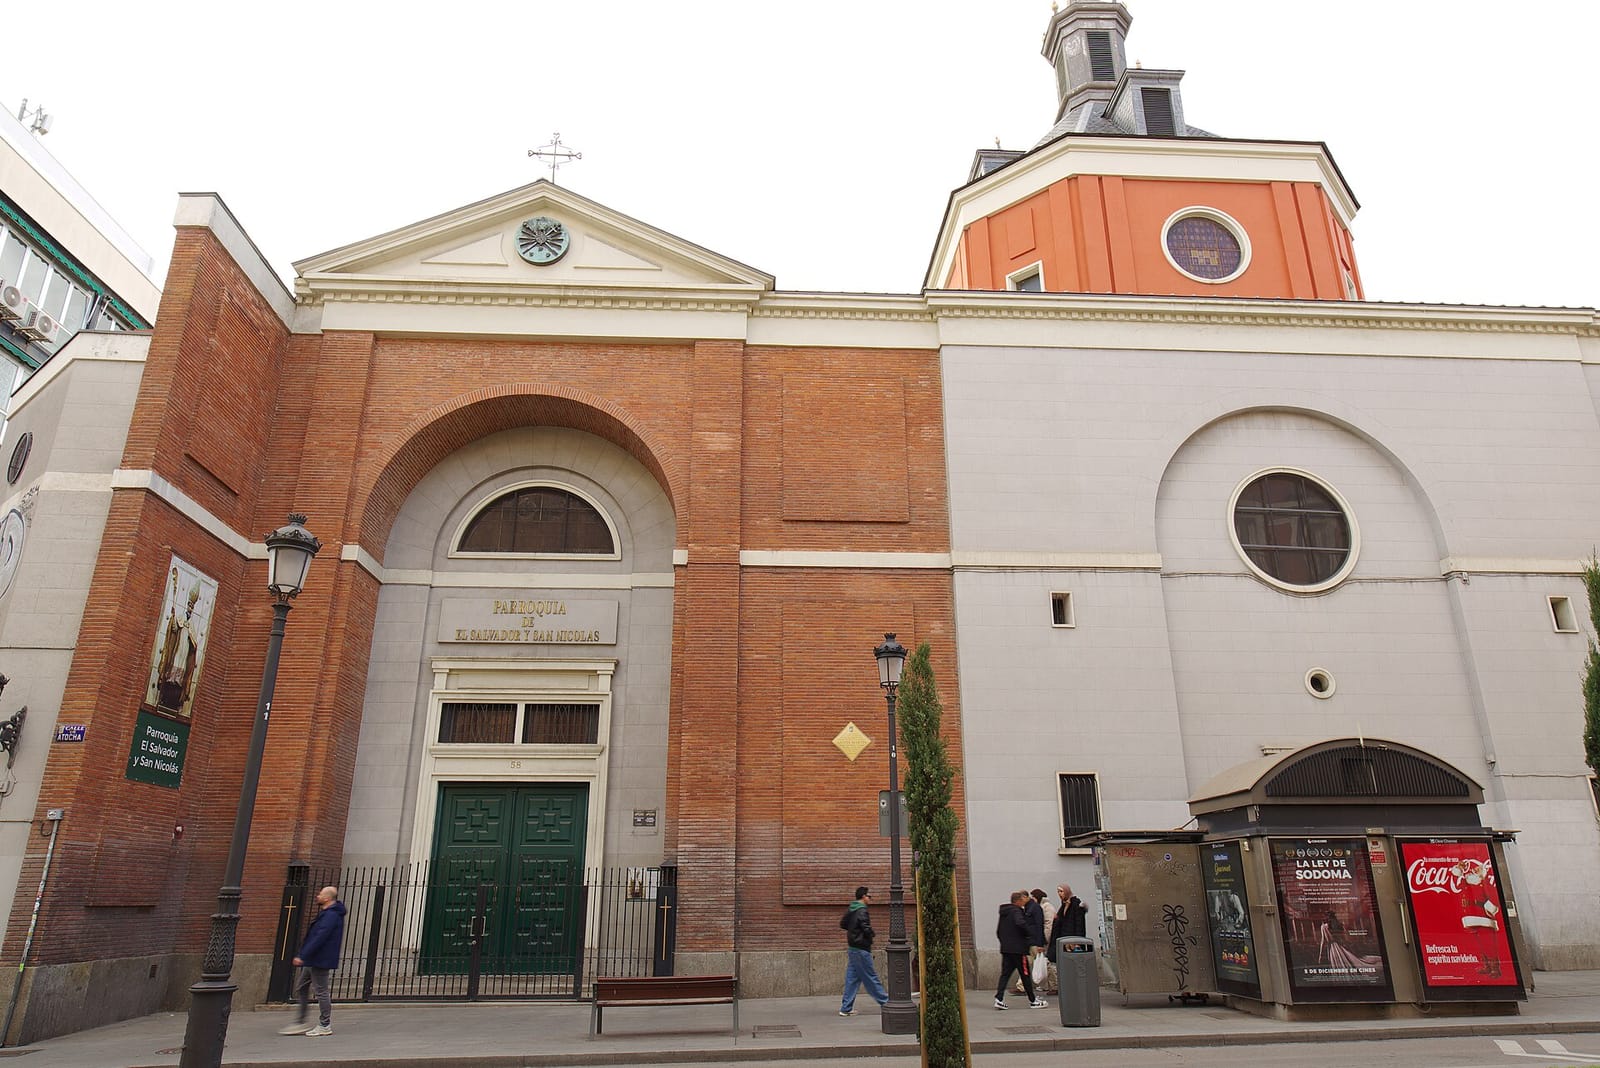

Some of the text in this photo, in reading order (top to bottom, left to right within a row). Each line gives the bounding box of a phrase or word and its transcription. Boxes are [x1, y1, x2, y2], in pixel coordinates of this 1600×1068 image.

[493, 600, 567, 617] PARROQUIA
[521, 617, 535, 628] DE
[455, 629, 600, 642] EL SALVADOR Y SAN NICOLAS
[57, 733, 82, 741] ATOCHA
[146, 726, 179, 744] Parroquia
[141, 740, 179, 758] El Salvador
[133, 755, 179, 774] y San Nicolás
[1296, 859, 1347, 868] LA LEY DE
[1295, 869, 1352, 880] SODOMA
[1407, 858, 1450, 894] Coca
[1425, 944, 1458, 953] Refresca tu
